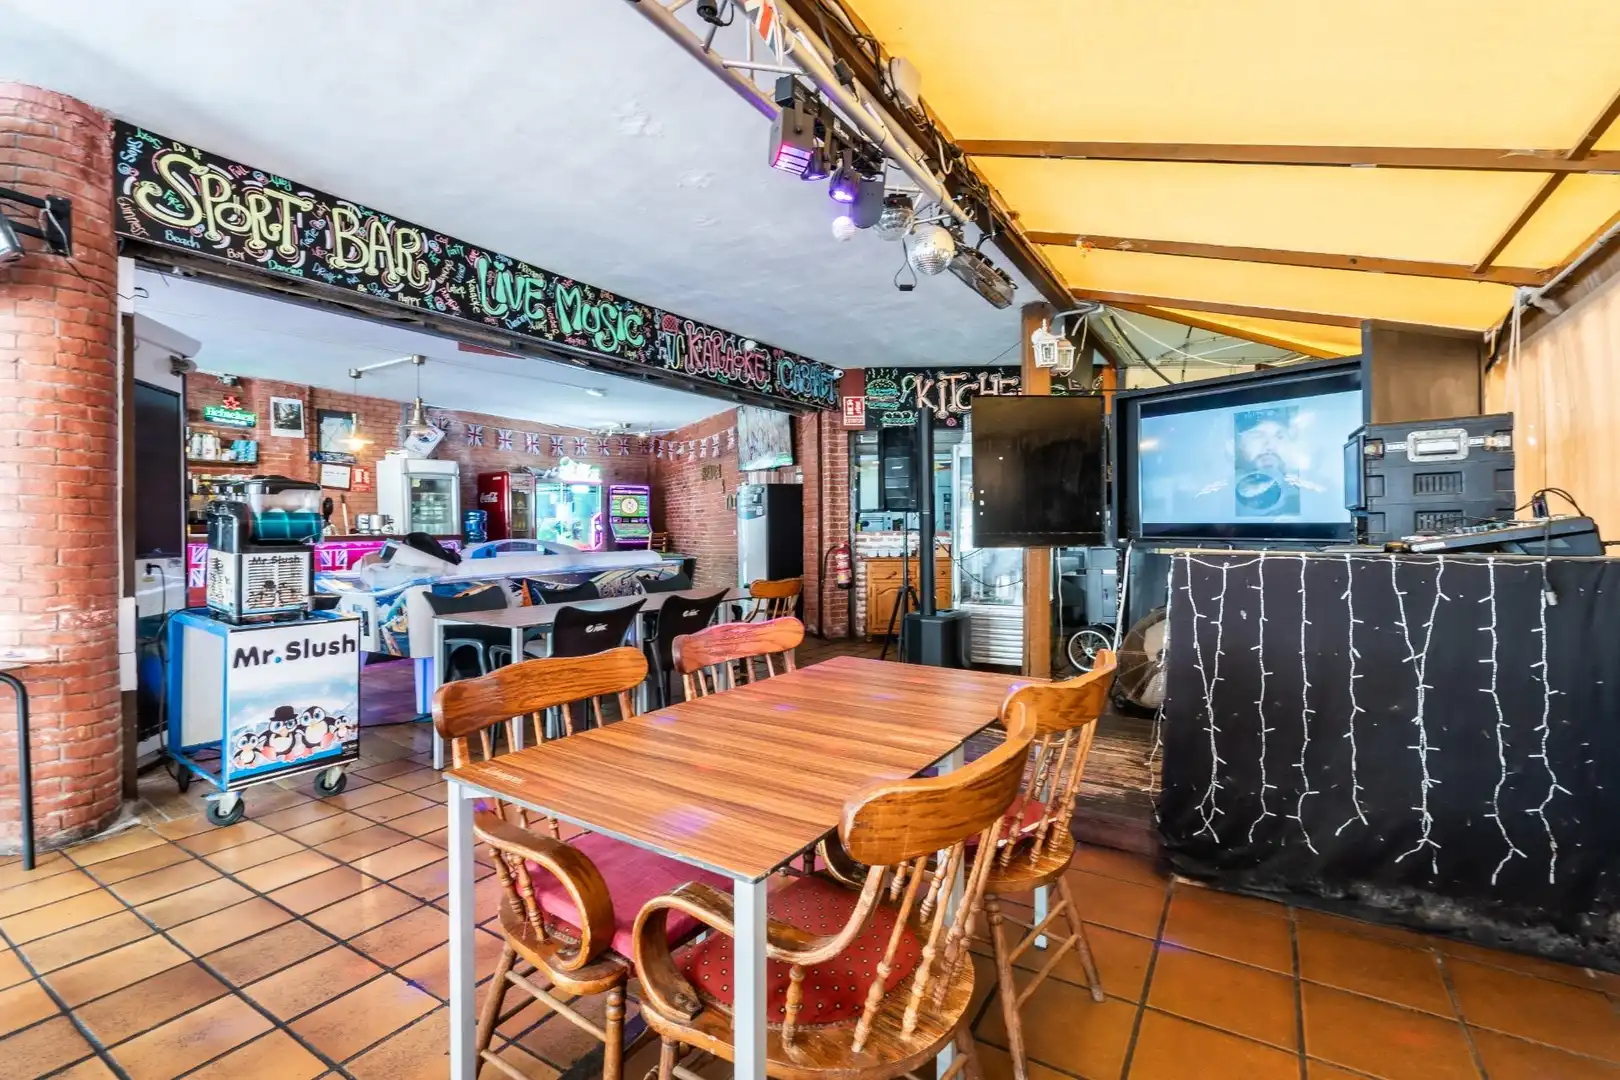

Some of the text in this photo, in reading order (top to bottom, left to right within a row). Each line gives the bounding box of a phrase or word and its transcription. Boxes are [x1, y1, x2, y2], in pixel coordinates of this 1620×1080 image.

[131, 153, 430, 287] SPORT BAR
[164, 229, 201, 249] Beach
[684, 321, 769, 386] KARAOKE
[915, 372, 1022, 419] KITCHE
